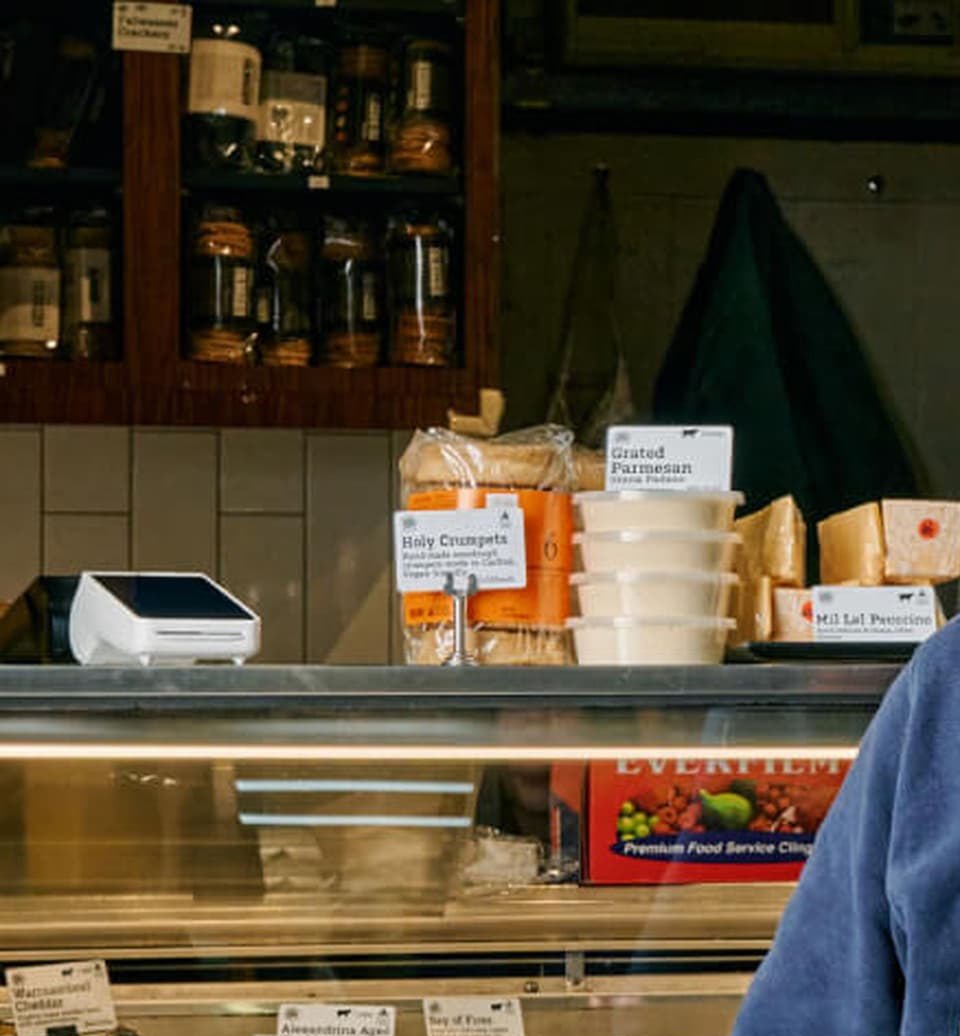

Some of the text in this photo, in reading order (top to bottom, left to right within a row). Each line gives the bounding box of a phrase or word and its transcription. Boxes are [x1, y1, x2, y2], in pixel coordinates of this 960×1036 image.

[611, 445, 666, 460] Grated
[611, 461, 692, 475] Parmesan
[402, 532, 509, 550] Holy Crumpets
[816, 613, 839, 626] Mil
[623, 841, 685, 855] Premium
[687, 841, 723, 855] Food
[725, 841, 776, 855] Service
